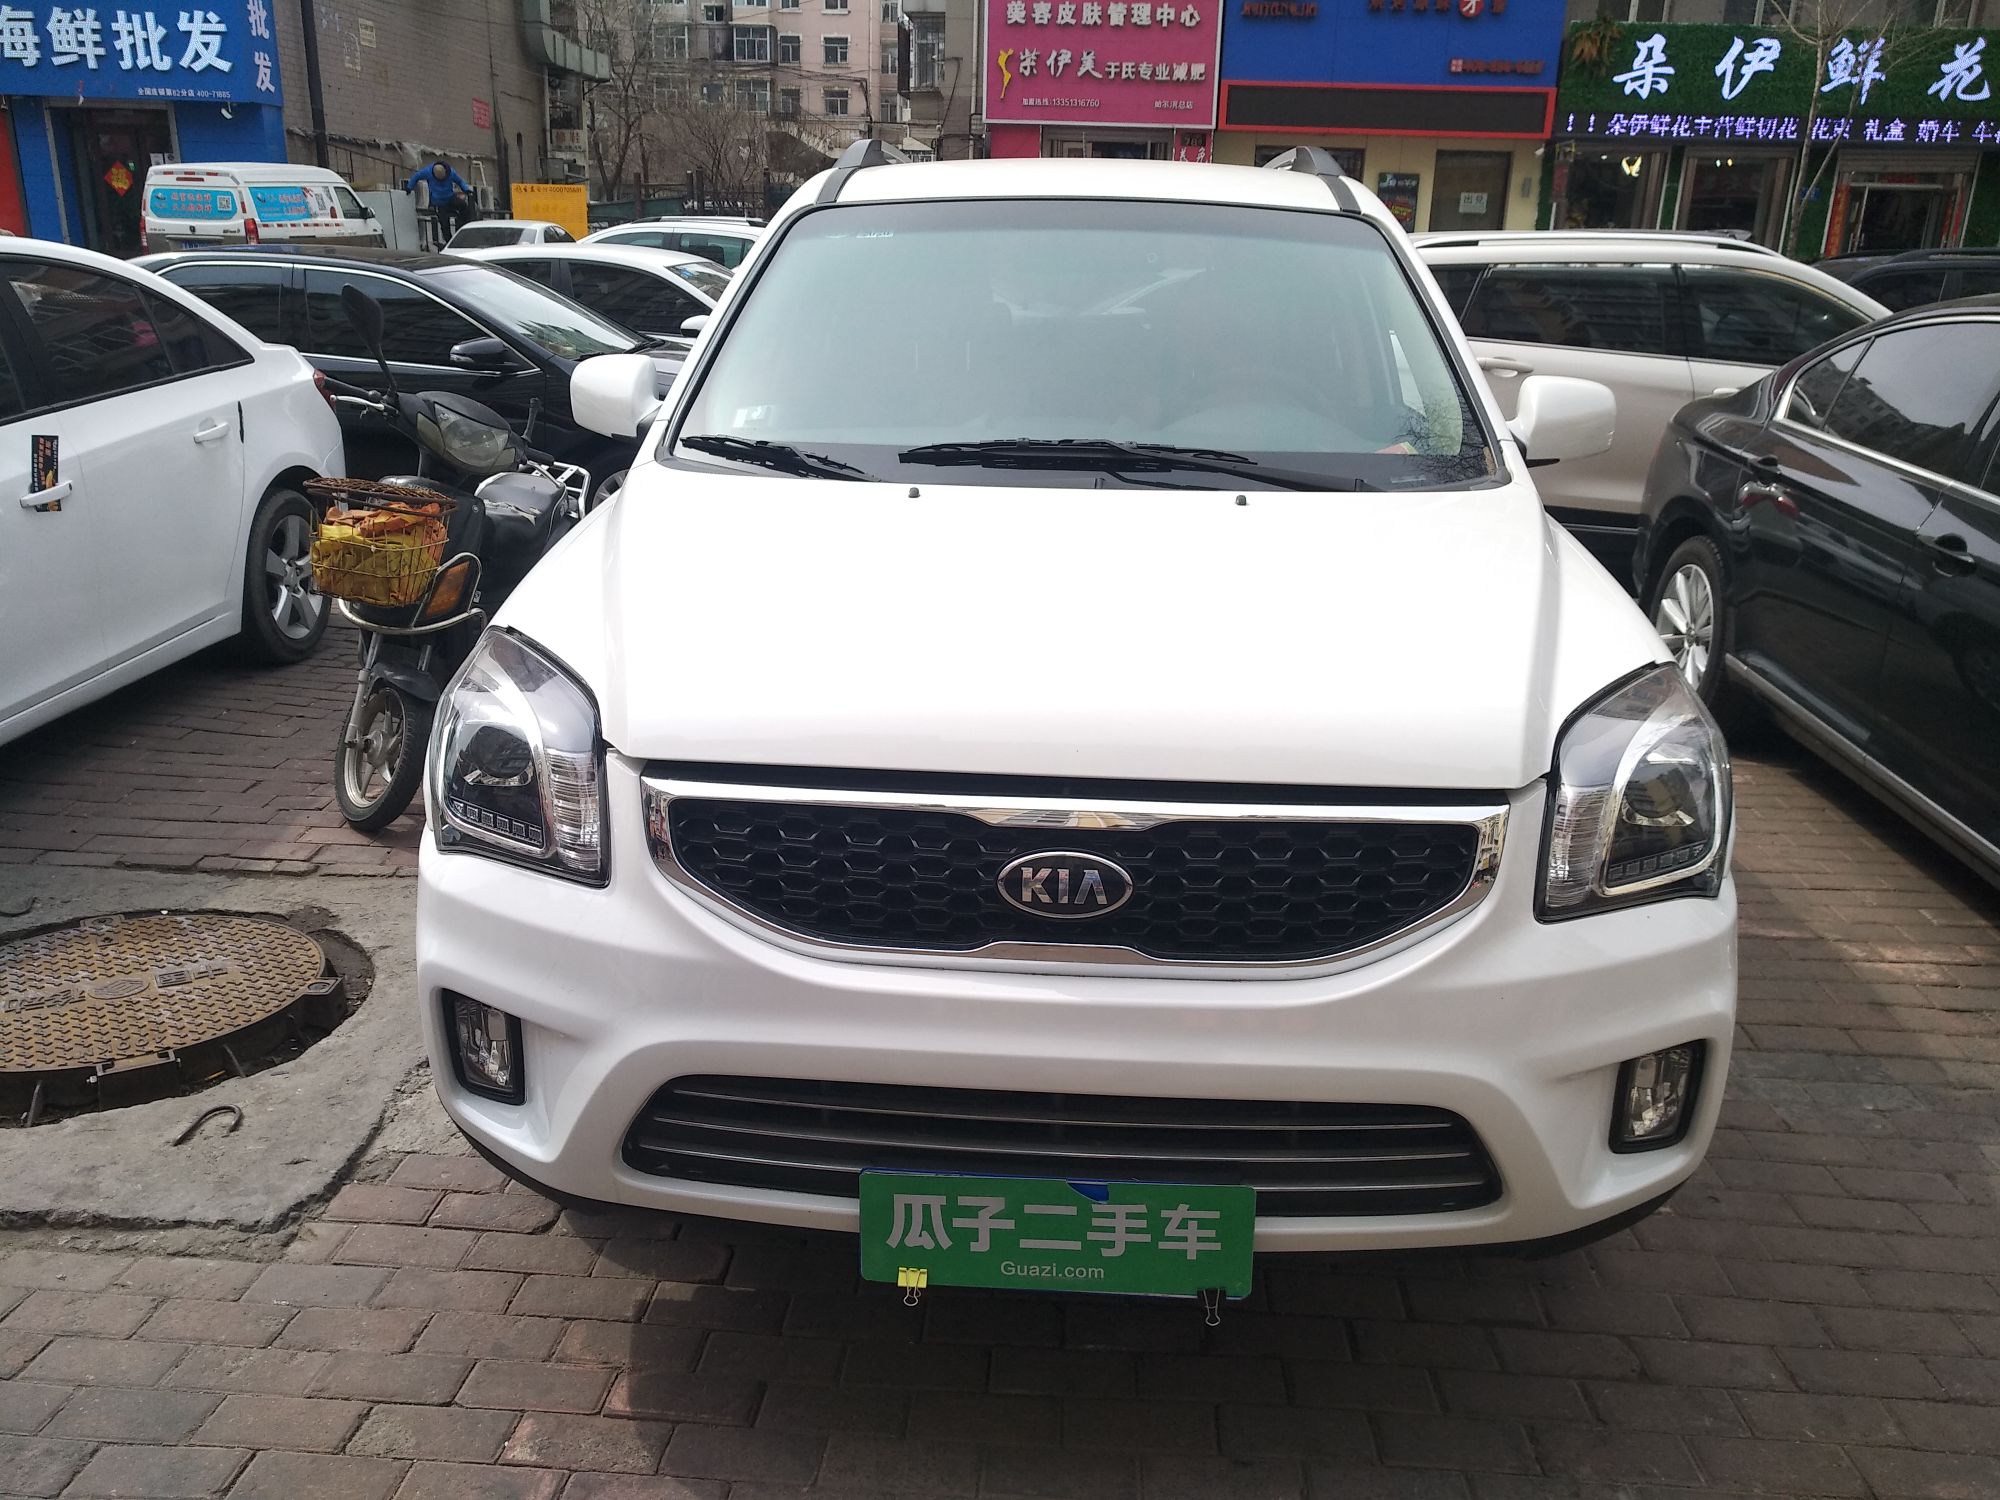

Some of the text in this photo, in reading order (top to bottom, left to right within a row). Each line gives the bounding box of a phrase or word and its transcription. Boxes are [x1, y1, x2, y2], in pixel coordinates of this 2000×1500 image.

[0, 5, 234, 74] 海鲜批发
[1007, 2, 1201, 27] 美容皮肤管理中心
[247, 0, 276, 94] 批发
[1105, 62, 1206, 82] 于氏专业减肥
[1612, 33, 1991, 105] 朵伊鲜花
[1020, 866, 1108, 905] KIA
[886, 1193, 1222, 1260] 瓜子二手车
[1000, 1261, 1105, 1280] Guazi.com
